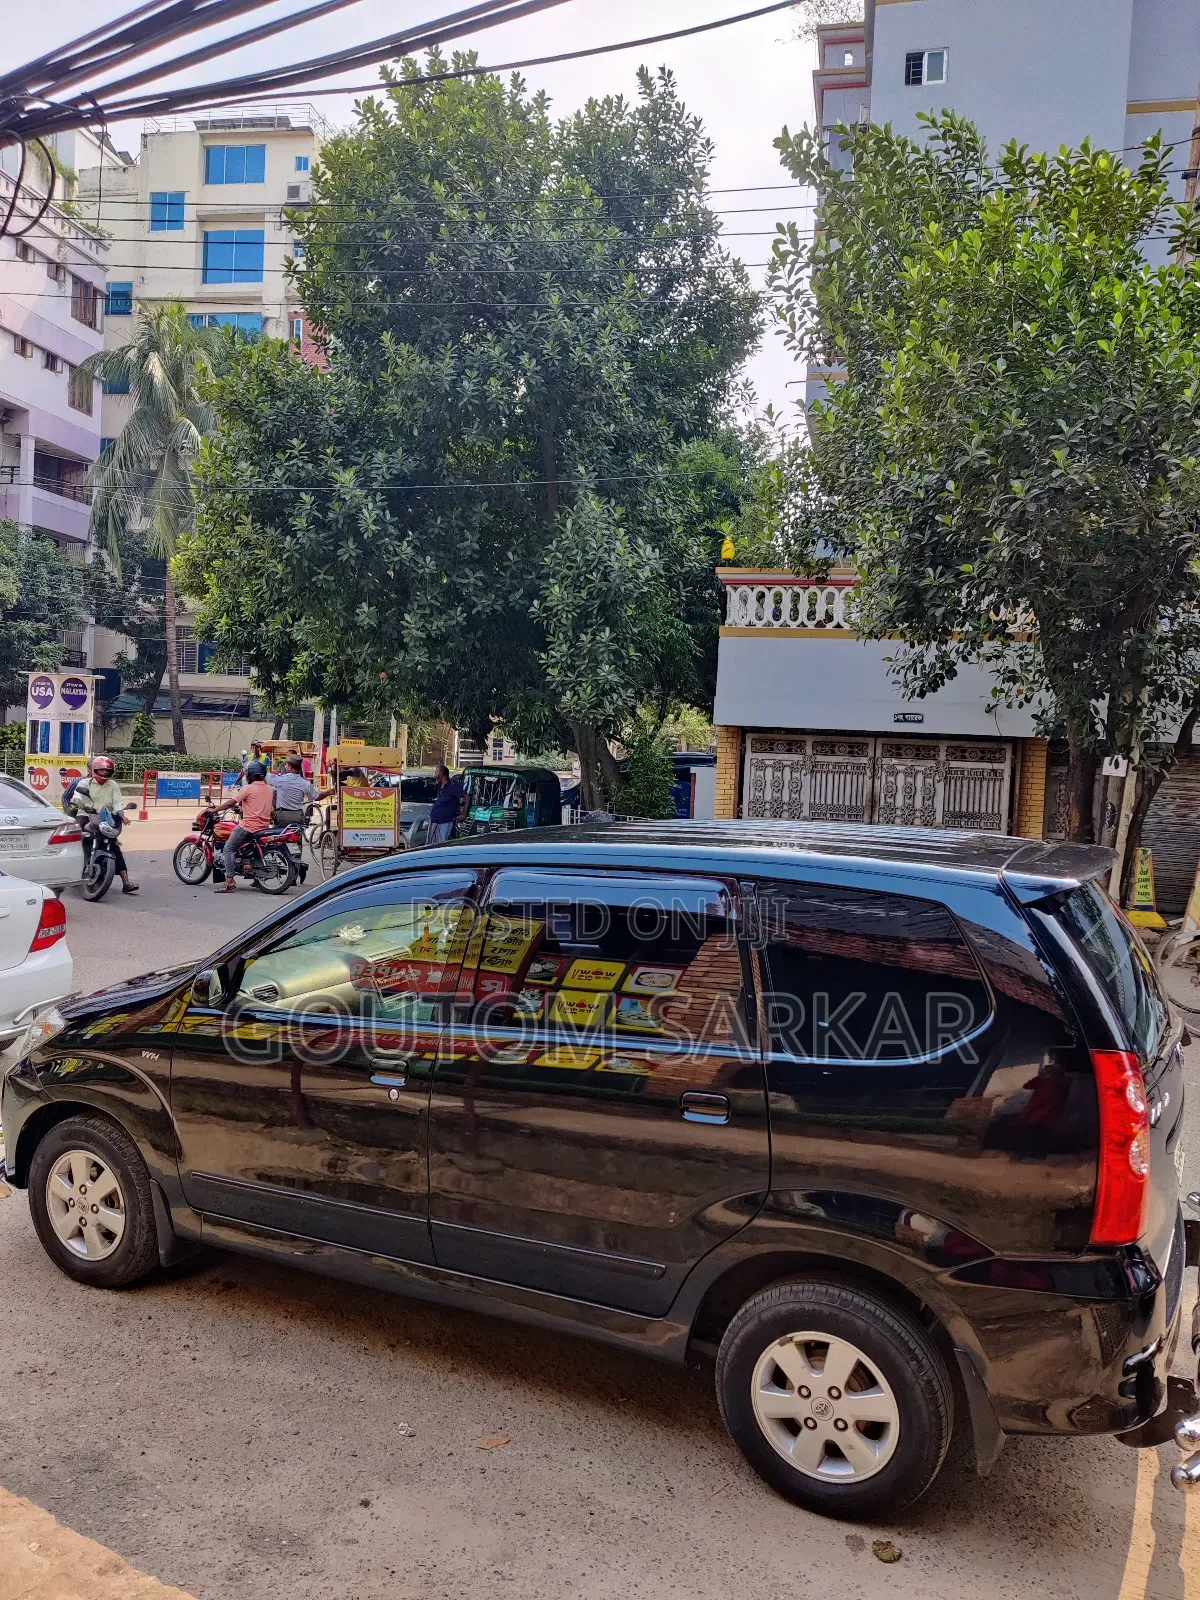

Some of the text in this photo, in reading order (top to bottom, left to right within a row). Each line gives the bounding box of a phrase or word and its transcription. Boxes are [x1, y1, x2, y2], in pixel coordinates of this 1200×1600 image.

[31, 687, 53, 697] USA
[60, 687, 87, 696] MALAYSIA
[31, 774, 48, 786] UK
